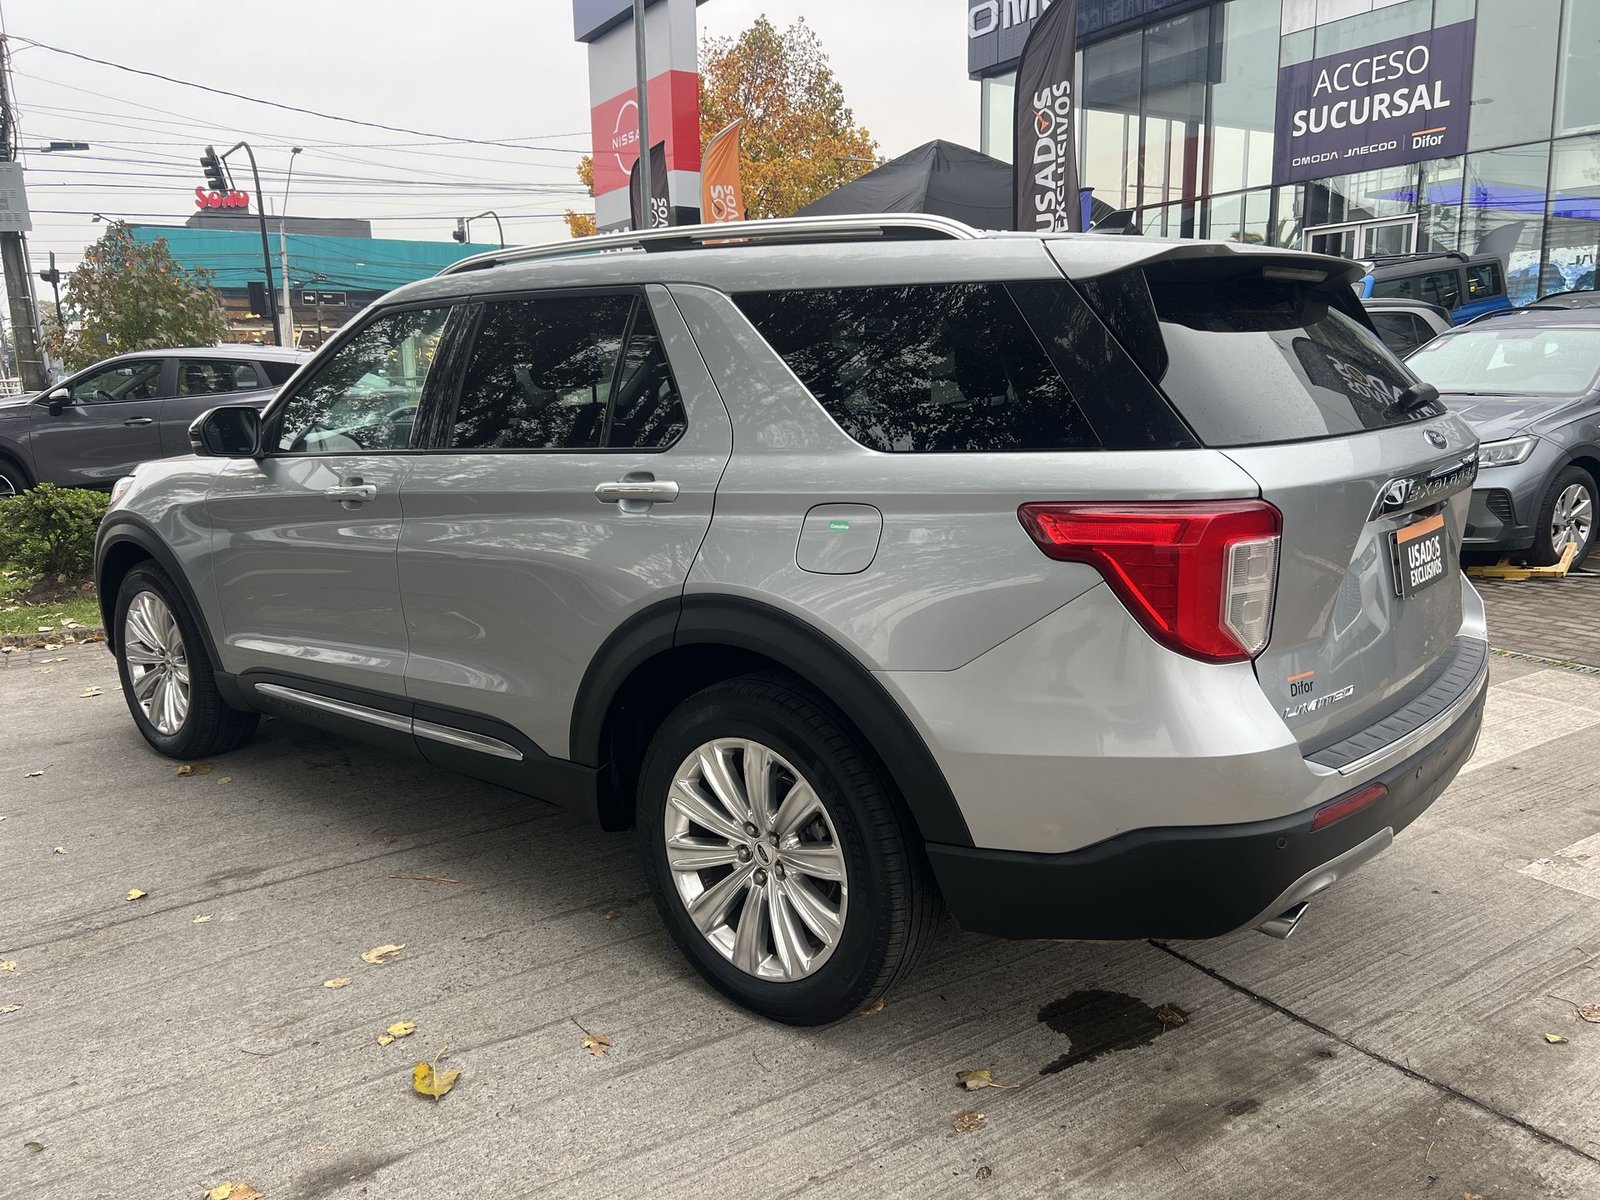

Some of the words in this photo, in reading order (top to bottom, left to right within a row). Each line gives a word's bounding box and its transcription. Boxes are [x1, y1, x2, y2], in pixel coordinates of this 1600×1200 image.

[1313, 45, 1429, 97] ACCESO
[1292, 80, 1450, 137] SUCURSAL
[612, 129, 639, 149] NISSA
[1292, 151, 1338, 166] OMODA
[1343, 140, 1397, 157] JAECOO
[1412, 134, 1444, 149] Difor
[1034, 87, 1056, 232] USADOS
[1052, 81, 1070, 232] EXCLUSIVOS
[1408, 535, 1440, 569] USADOS
[1411, 557, 1442, 587] EXCLUSIVOS
[1290, 680, 1314, 697] Difor
